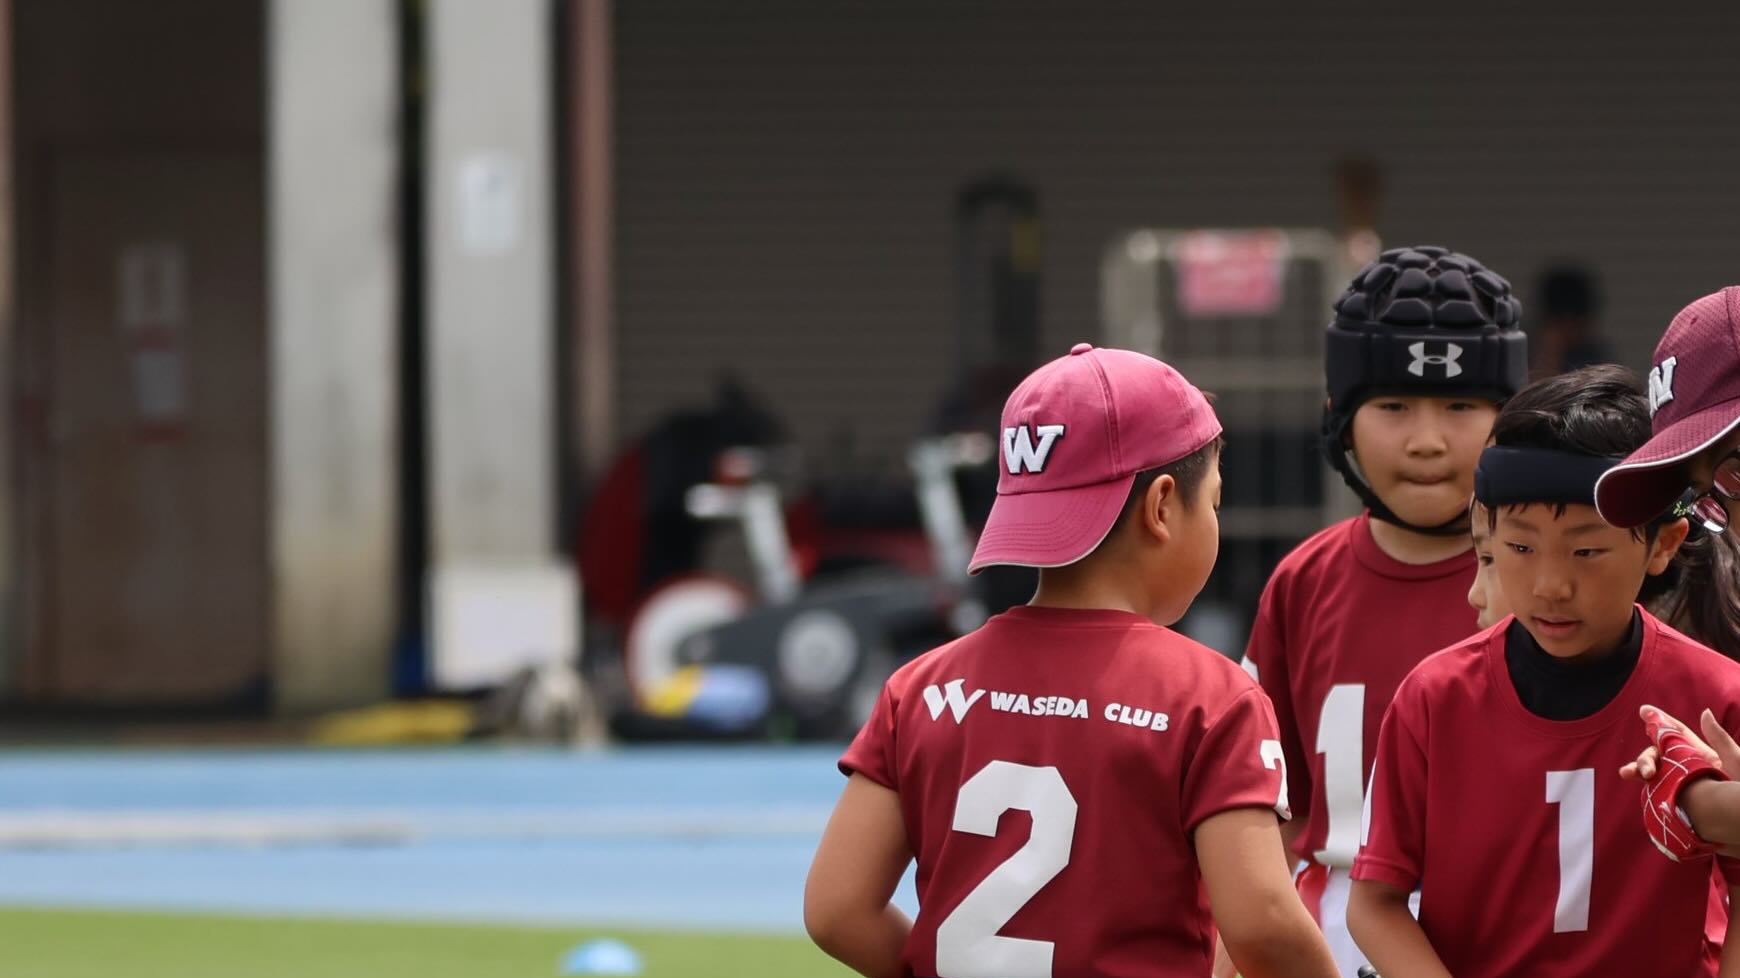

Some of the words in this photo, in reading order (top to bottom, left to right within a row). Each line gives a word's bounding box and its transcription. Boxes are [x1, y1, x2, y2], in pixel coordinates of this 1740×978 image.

[1003, 424, 1065, 475] W
[990, 691, 1089, 719] WASEDA
[1104, 702, 1169, 732] CLUB
[1545, 768, 1596, 932] 1
